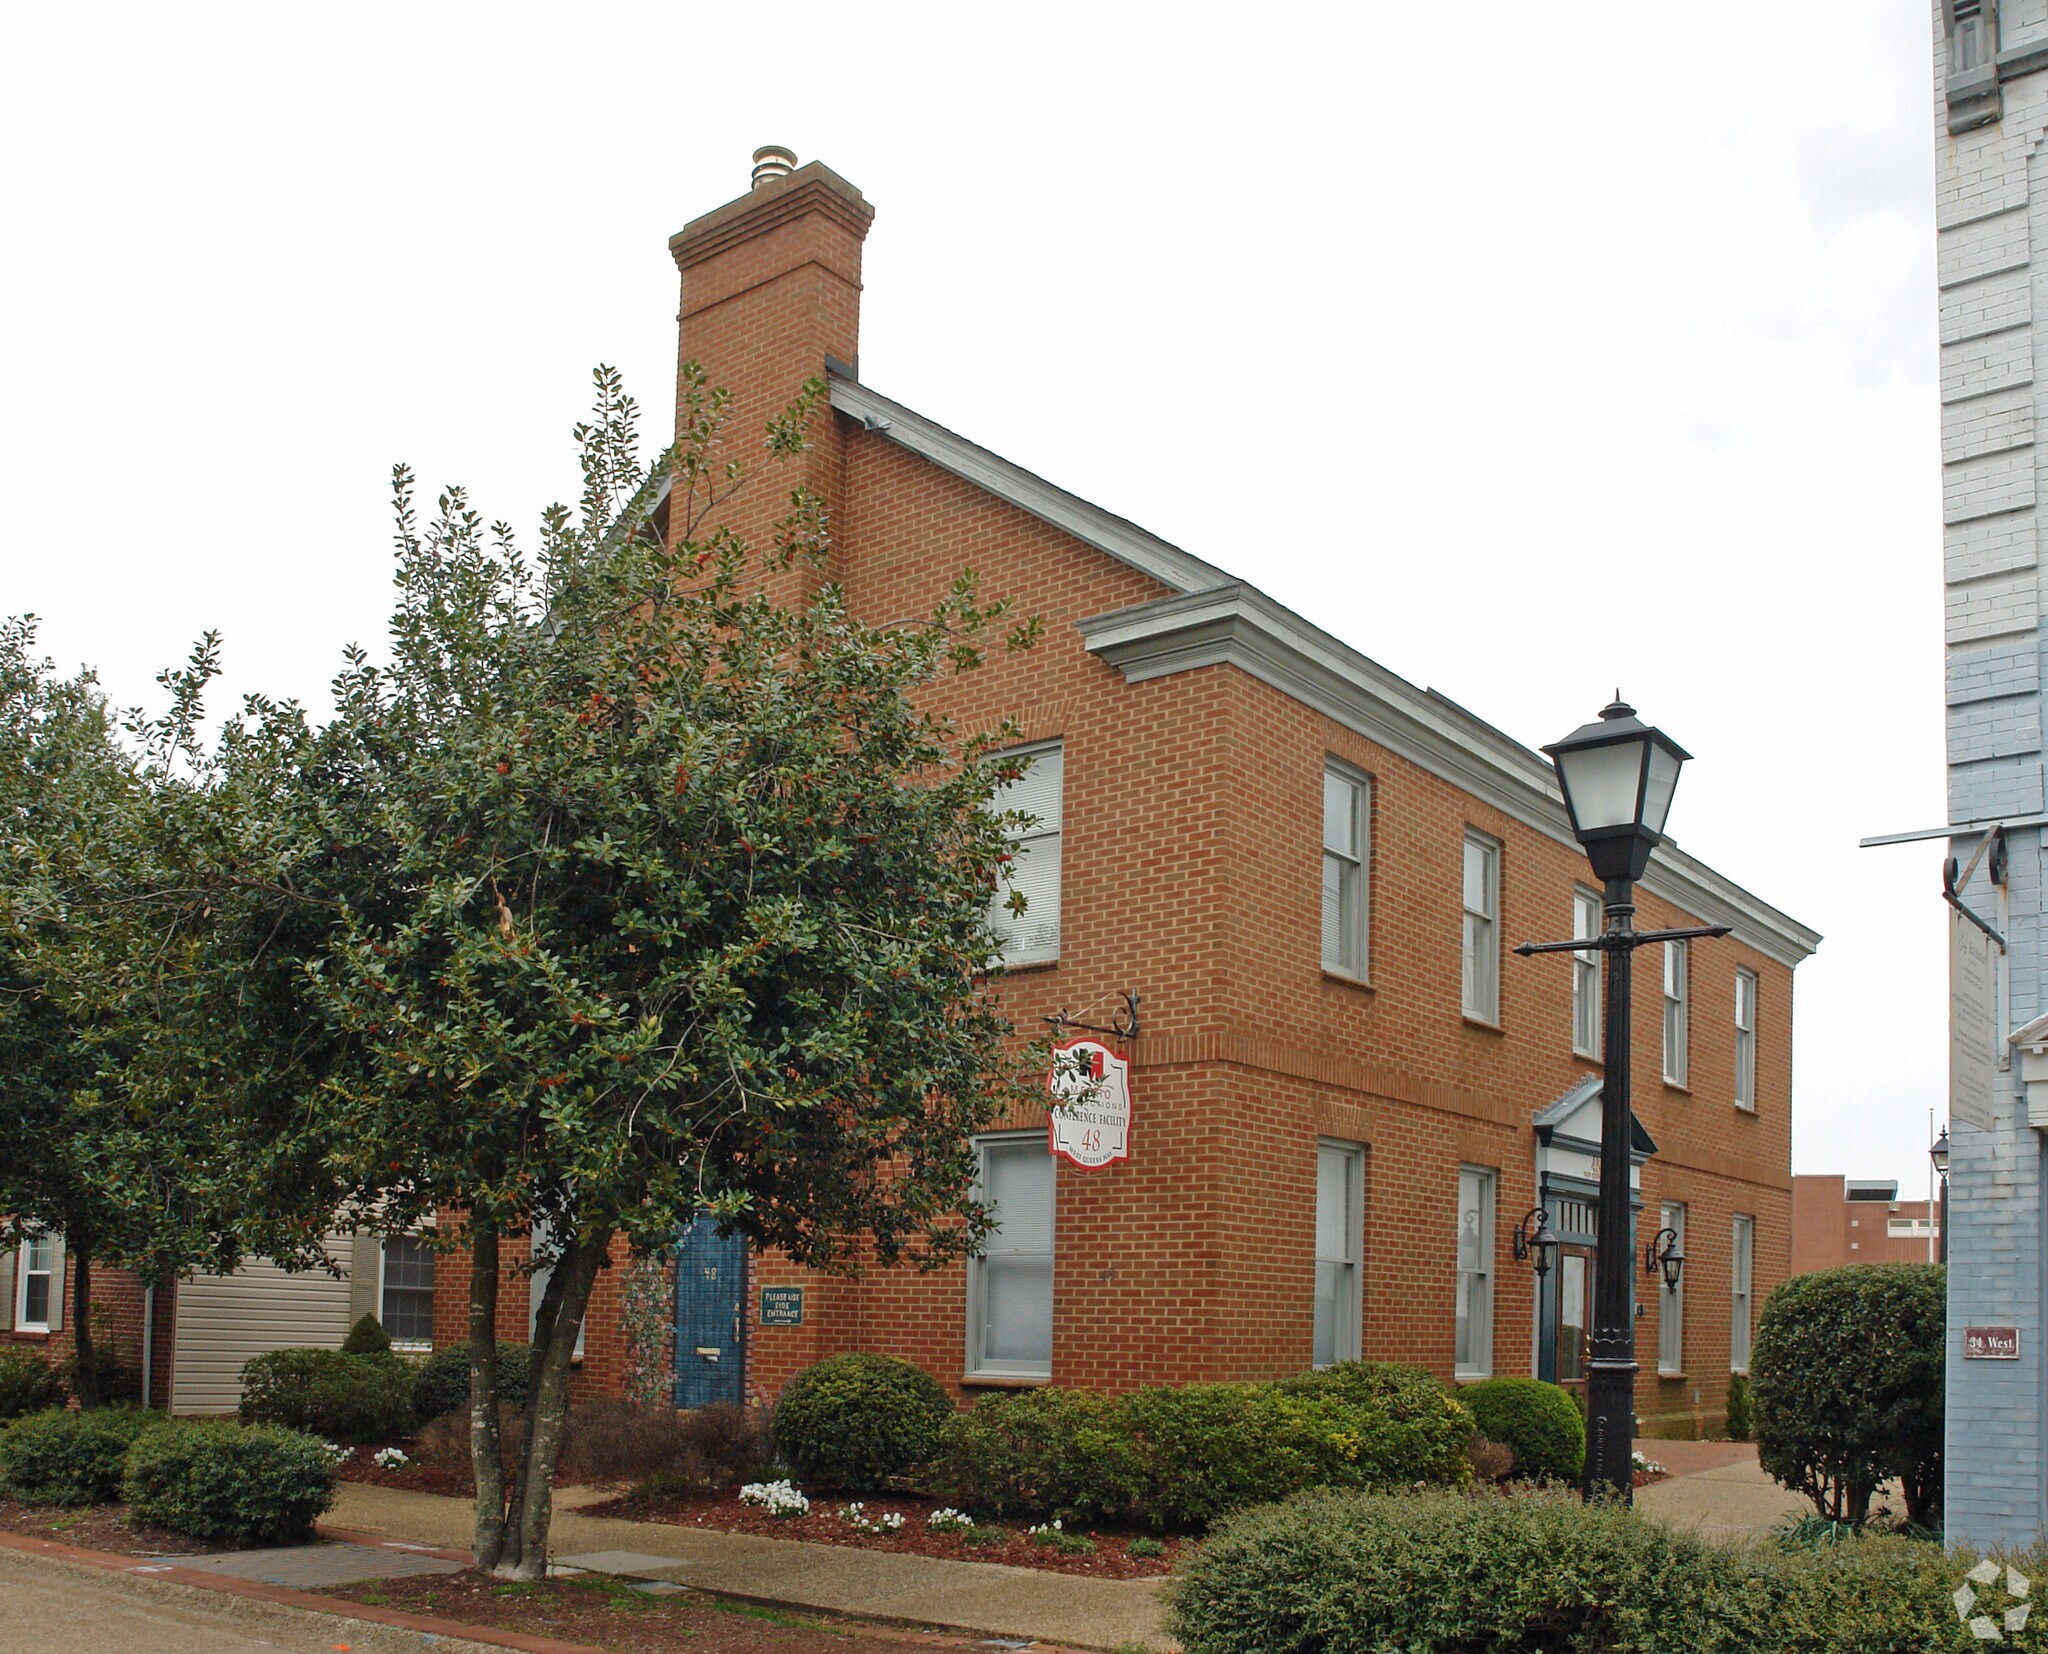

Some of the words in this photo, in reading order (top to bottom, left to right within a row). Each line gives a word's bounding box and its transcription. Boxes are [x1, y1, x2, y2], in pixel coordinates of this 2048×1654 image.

[1099, 1114, 1126, 1128] FACILITY
[1081, 1128, 1101, 1152] 48
[1069, 1146, 1082, 1160] WEST
[1082, 1155, 1103, 1164] QUEENS
[704, 1267, 717, 1280] 48
[765, 1292, 787, 1302] PLEASE
[788, 1293, 800, 1302] USE
[774, 1301, 790, 1310] SIDE
[766, 1309, 798, 1319] ENTRANCE
[1987, 1336, 2013, 1349] West
